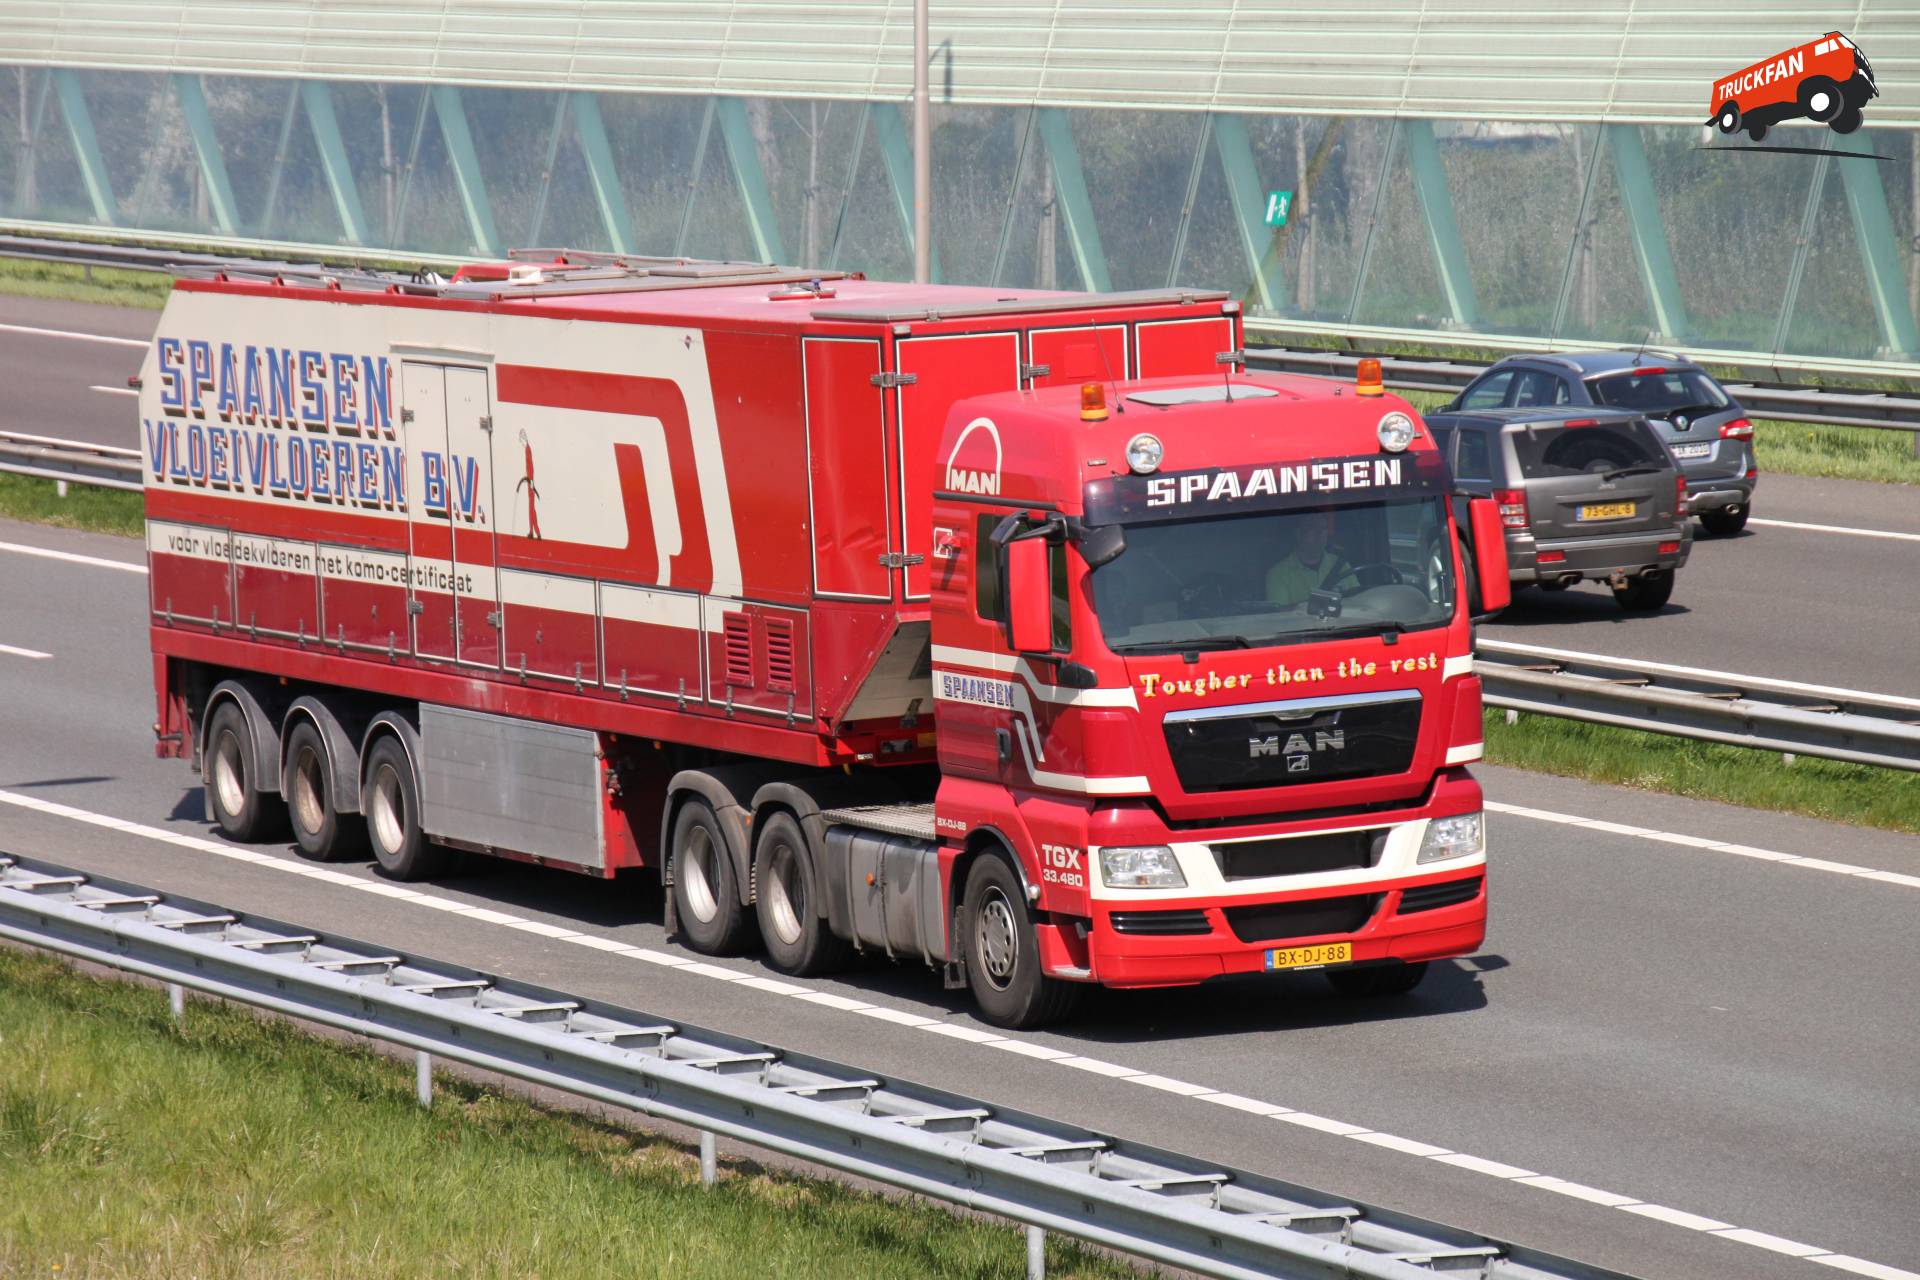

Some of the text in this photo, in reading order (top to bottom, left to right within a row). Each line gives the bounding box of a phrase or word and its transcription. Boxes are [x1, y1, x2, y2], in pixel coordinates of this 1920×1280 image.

[157, 336, 397, 441] SPAANSEN
[144, 418, 409, 514] VLOEIVLOEREN
[950, 468, 996, 496] MAN
[1147, 459, 1401, 507] SPAANSEN
[168, 533, 200, 554] voor
[315, 554, 342, 575] met
[346, 553, 473, 593] komo-certificaat
[1140, 652, 1438, 698] Tougher than the rest
[943, 675, 1015, 708] SPAANSEN
[1249, 729, 1345, 758] MAN
[936, 817, 967, 831] BX-DJ-88
[1041, 844, 1082, 870] TGX
[1042, 869, 1084, 887] 33.480
[1278, 945, 1346, 966] BX-DJ-88
